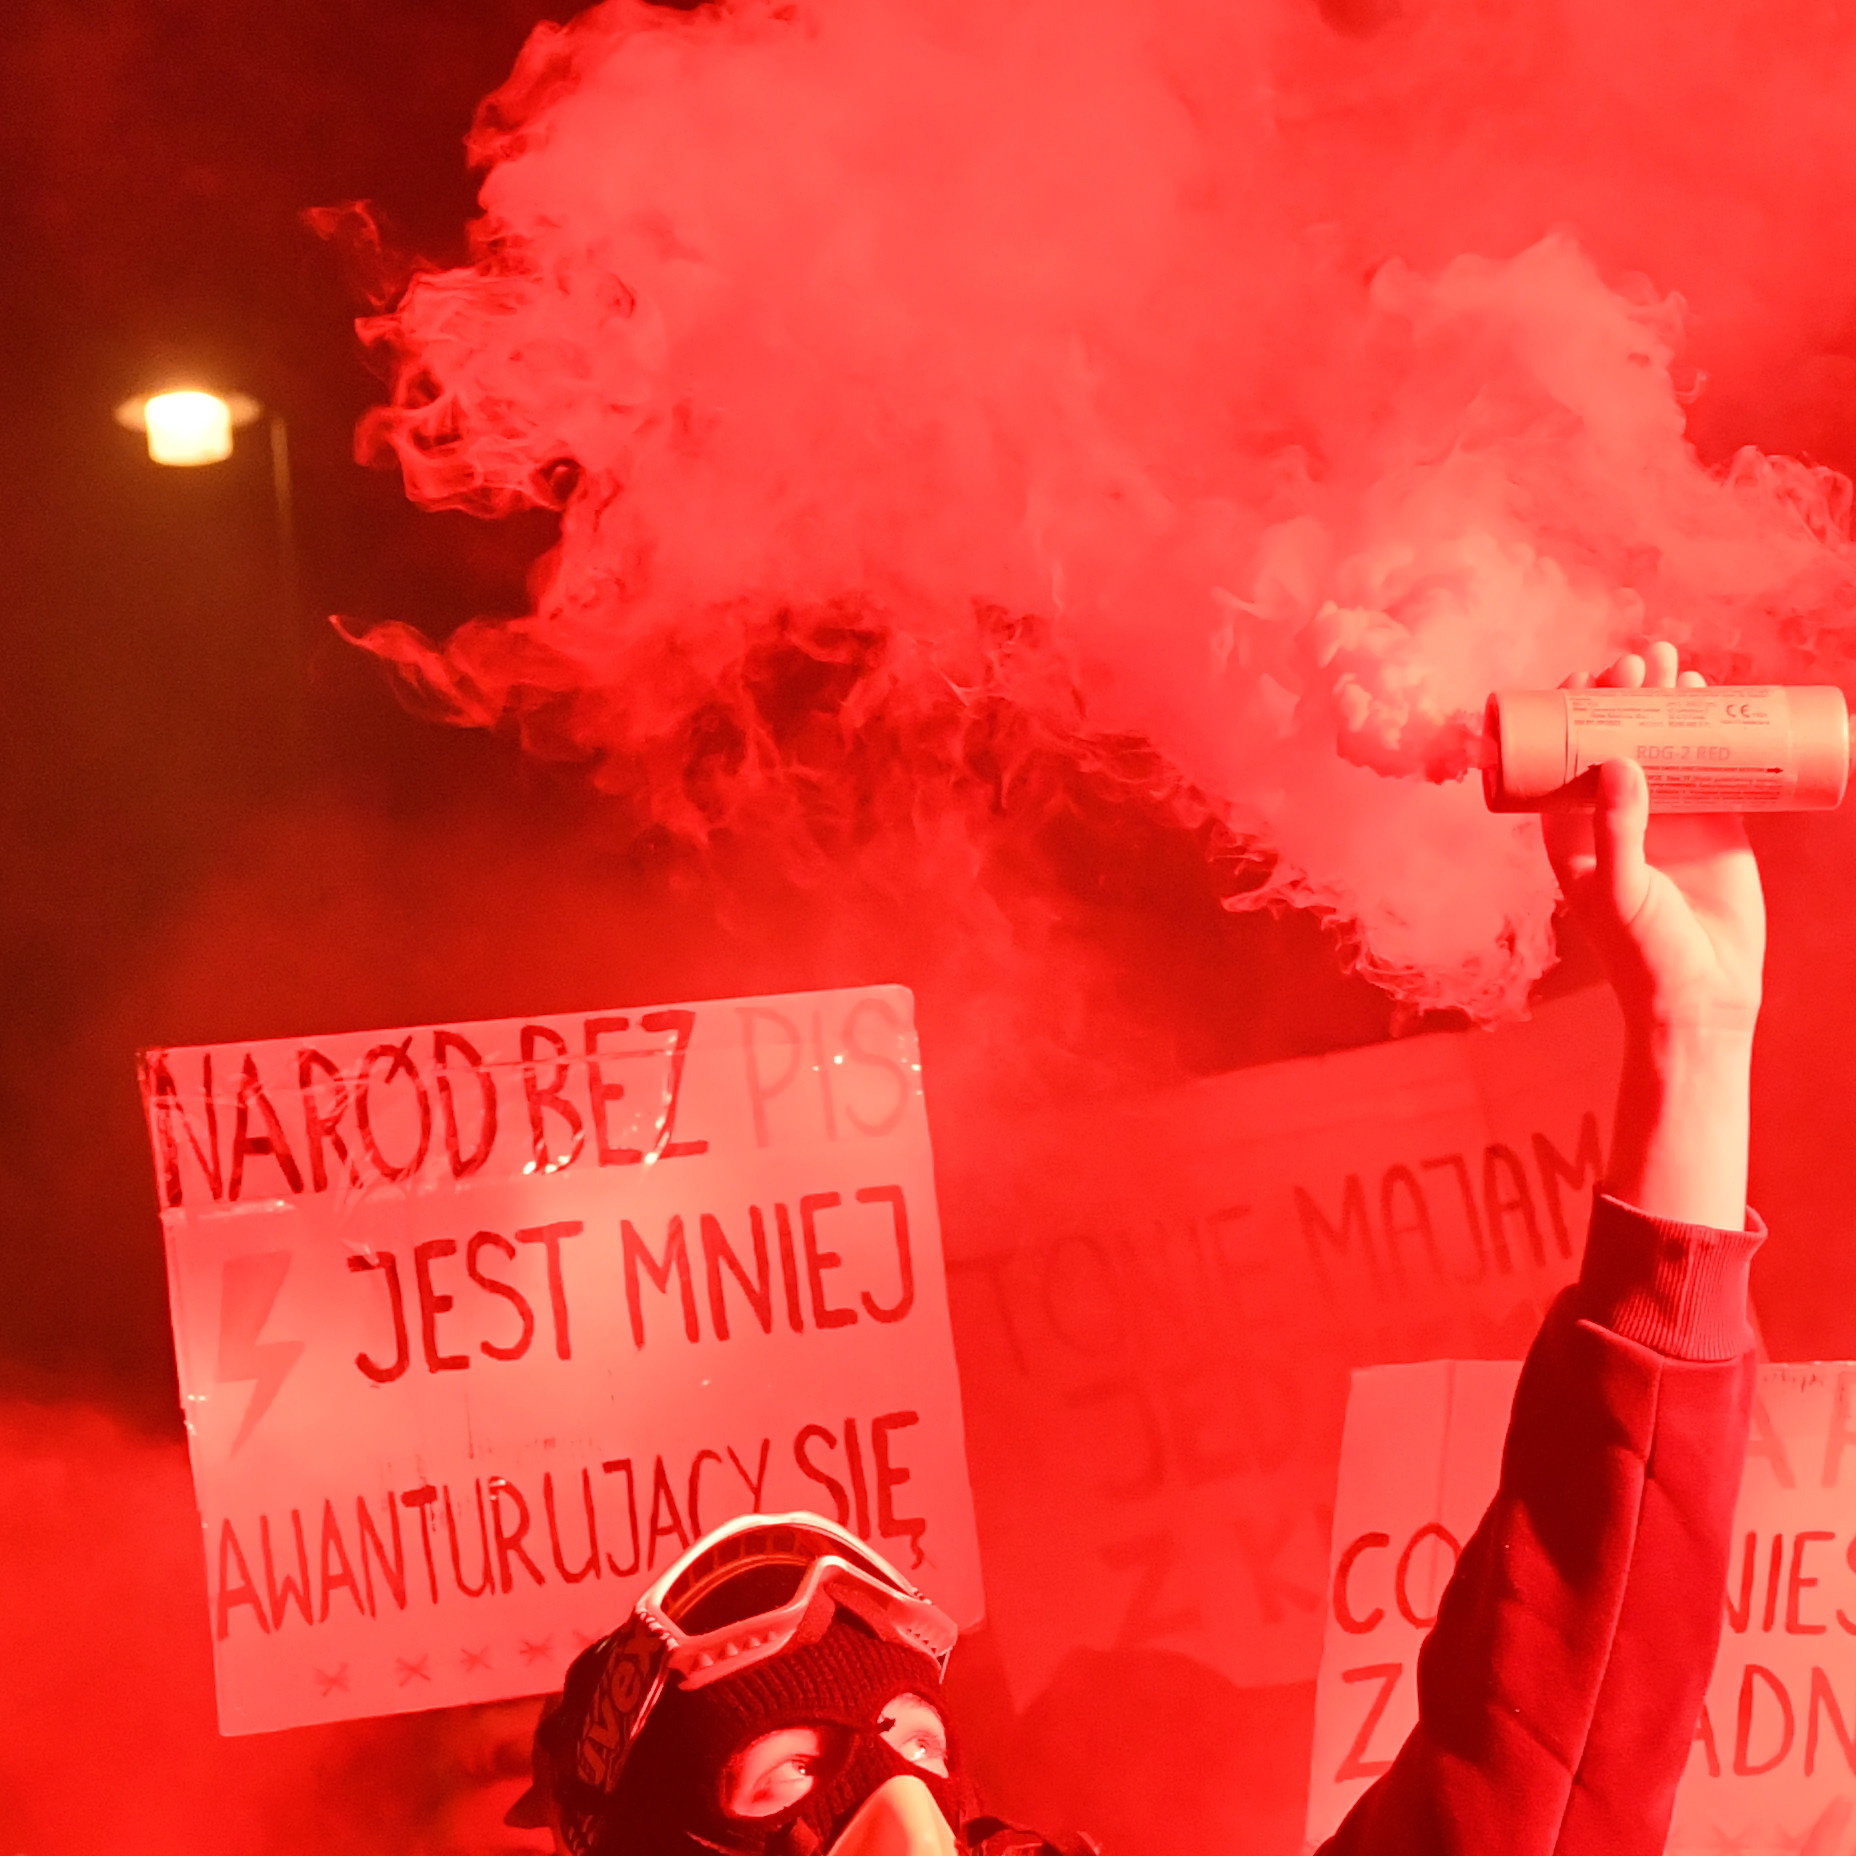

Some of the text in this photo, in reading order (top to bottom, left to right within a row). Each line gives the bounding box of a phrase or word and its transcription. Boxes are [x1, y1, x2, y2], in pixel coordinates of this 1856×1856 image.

[1636, 745, 1731, 762] RDG-2 RED
[148, 1000, 908, 1205] NARÓD BEZ PIS
[347, 1186, 916, 1383] JEST MNIEJ
[794, 1410, 926, 1570] SIĘ
